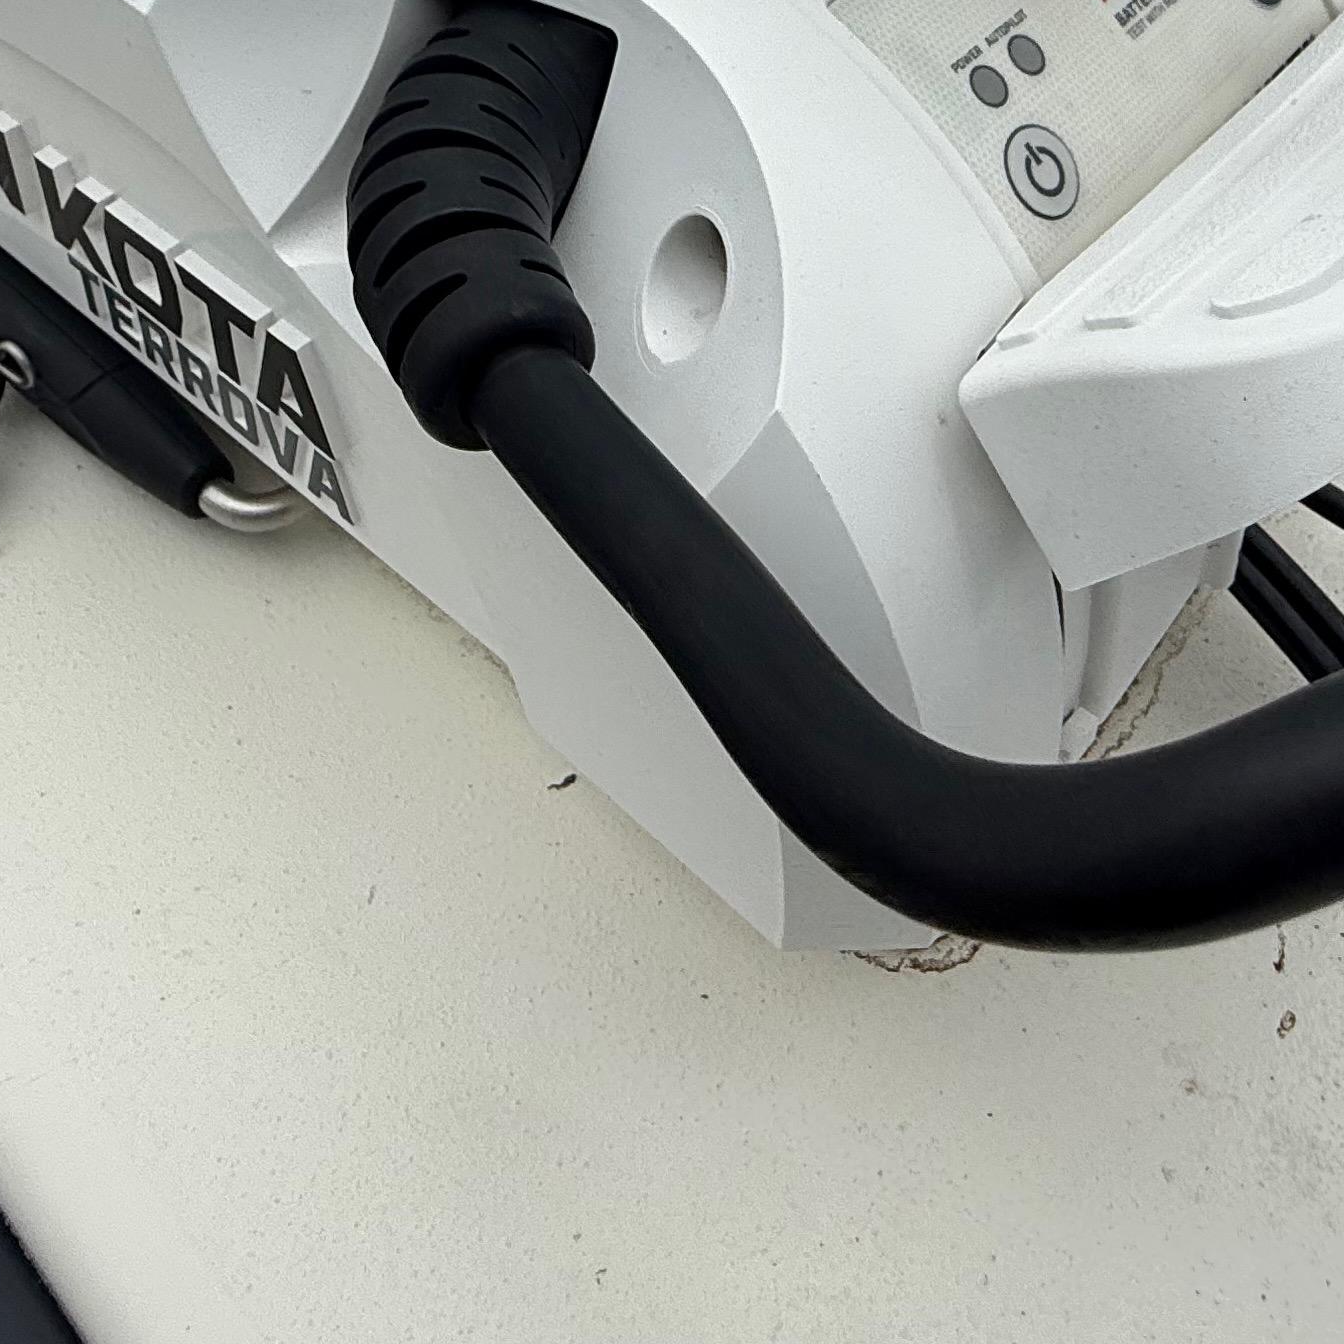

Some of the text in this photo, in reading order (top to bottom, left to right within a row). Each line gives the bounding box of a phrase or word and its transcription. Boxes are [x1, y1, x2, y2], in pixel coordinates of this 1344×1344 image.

[951, 9, 1029, 74] POWER AUTOPILOT
[1127, 18, 1147, 41] TEST
[1145, 3, 1167, 26] WITH
[34, 144, 336, 460] KOTA
[67, 251, 355, 526] TERROVA
